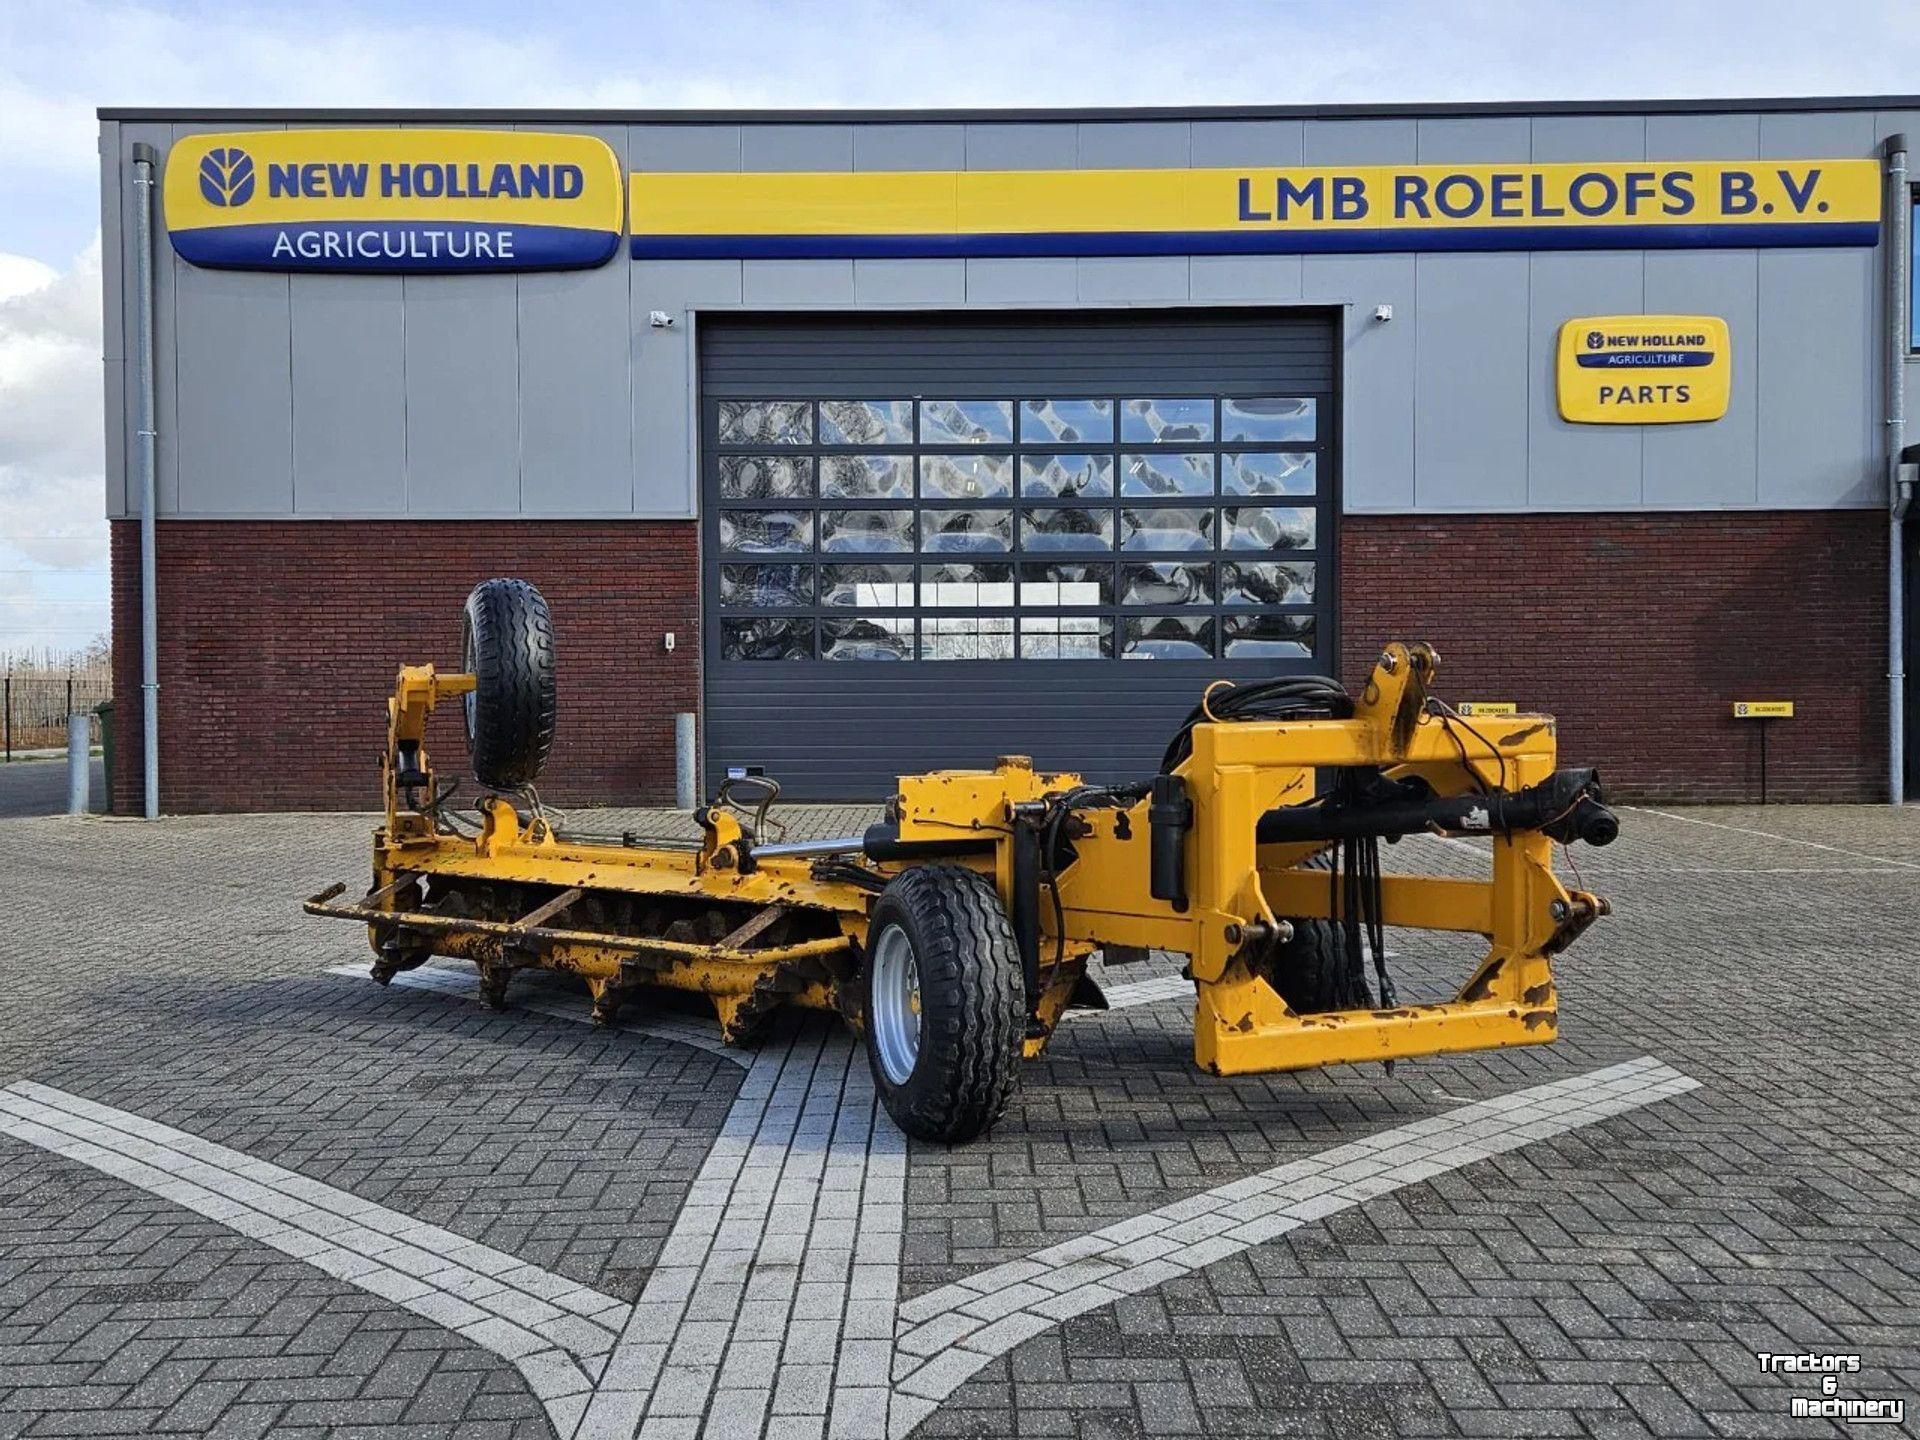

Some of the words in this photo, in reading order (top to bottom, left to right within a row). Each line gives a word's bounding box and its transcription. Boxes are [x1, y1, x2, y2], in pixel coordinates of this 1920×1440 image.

[268, 163, 370, 198] NEW
[379, 163, 583, 199] HOLLAND
[1238, 176, 1369, 221] LMB
[1395, 171, 1695, 219] ROELOFS
[1720, 169, 1829, 215] B.V.
[271, 230, 515, 259] AGRICULTURE
[1608, 335, 1639, 346] NEW
[1642, 335, 1705, 346] HOLLAND
[1608, 354, 1684, 364] AGRICULTURE
[1600, 386, 1690, 404] PARTS
